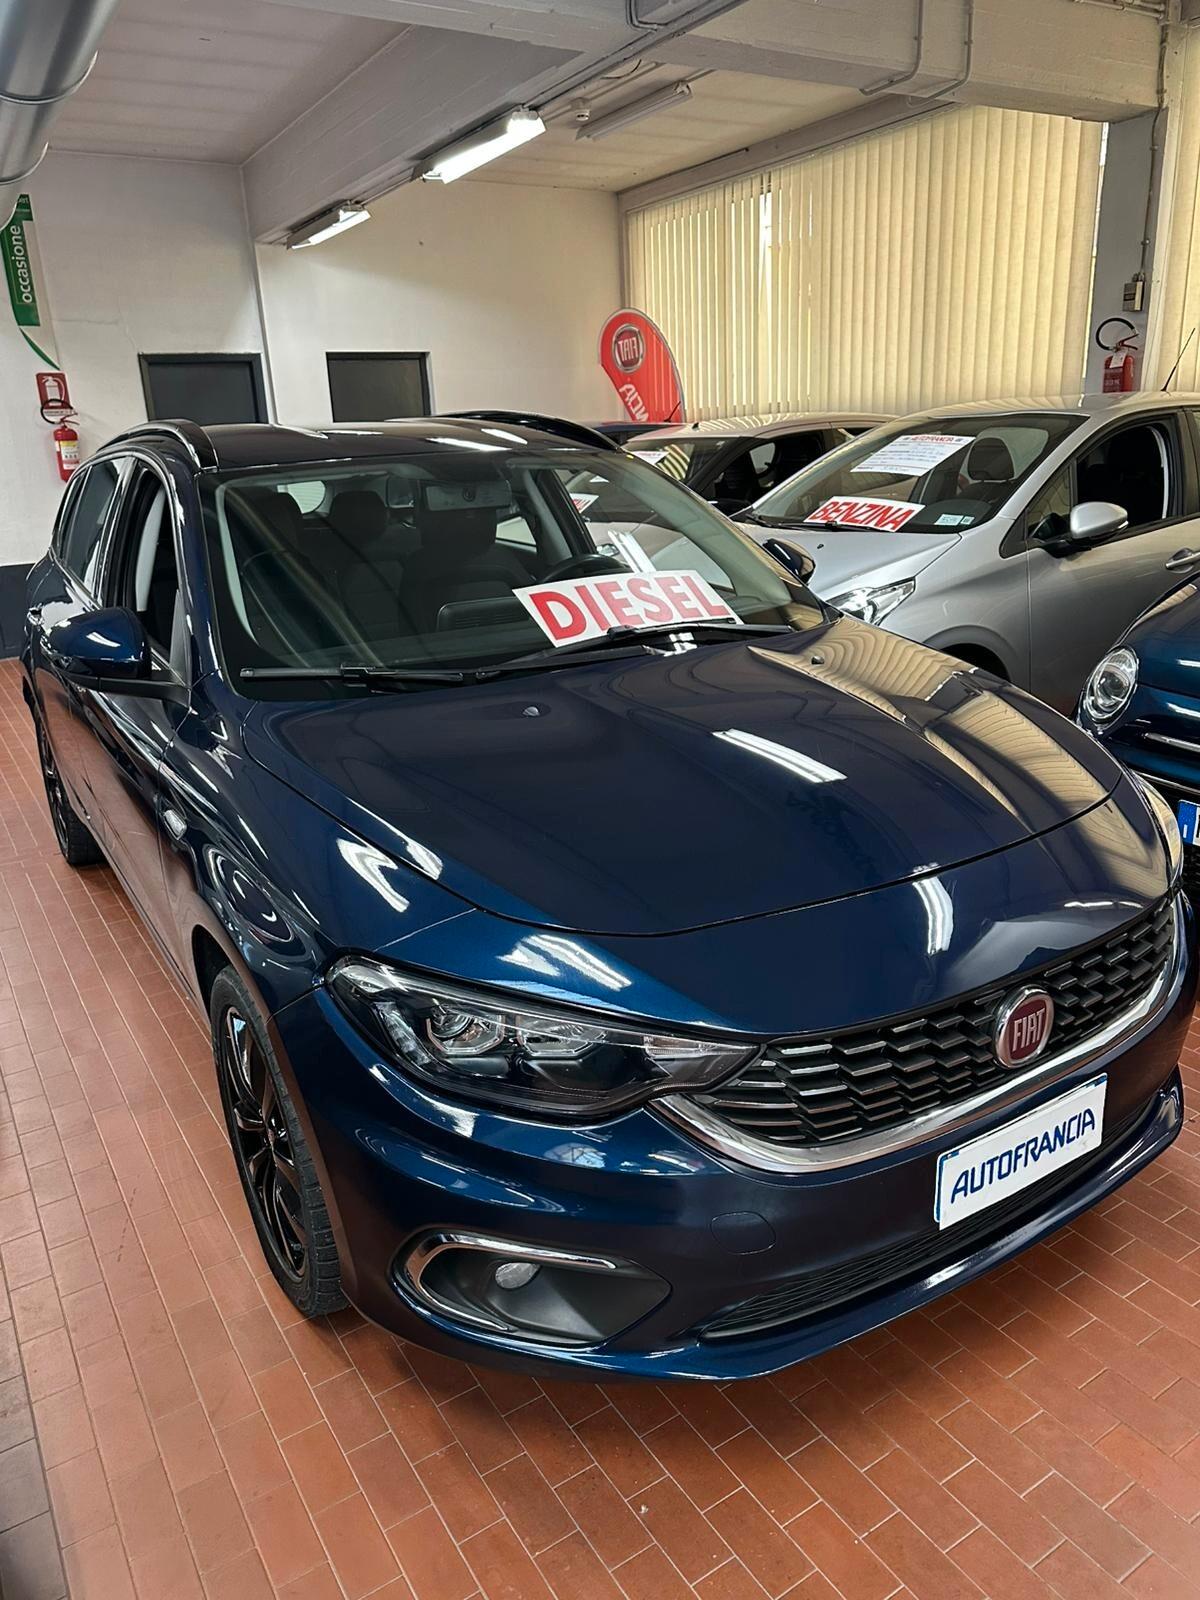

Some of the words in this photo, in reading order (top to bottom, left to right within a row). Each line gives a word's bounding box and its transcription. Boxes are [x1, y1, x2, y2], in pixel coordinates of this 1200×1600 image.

[10, 225, 32, 303] occasione
[809, 501, 915, 529] BENZINA
[529, 576, 730, 641] DIESEL
[1012, 1007, 1046, 1052] FIAT
[950, 1107, 1095, 1203] AUTOFRANCIA
